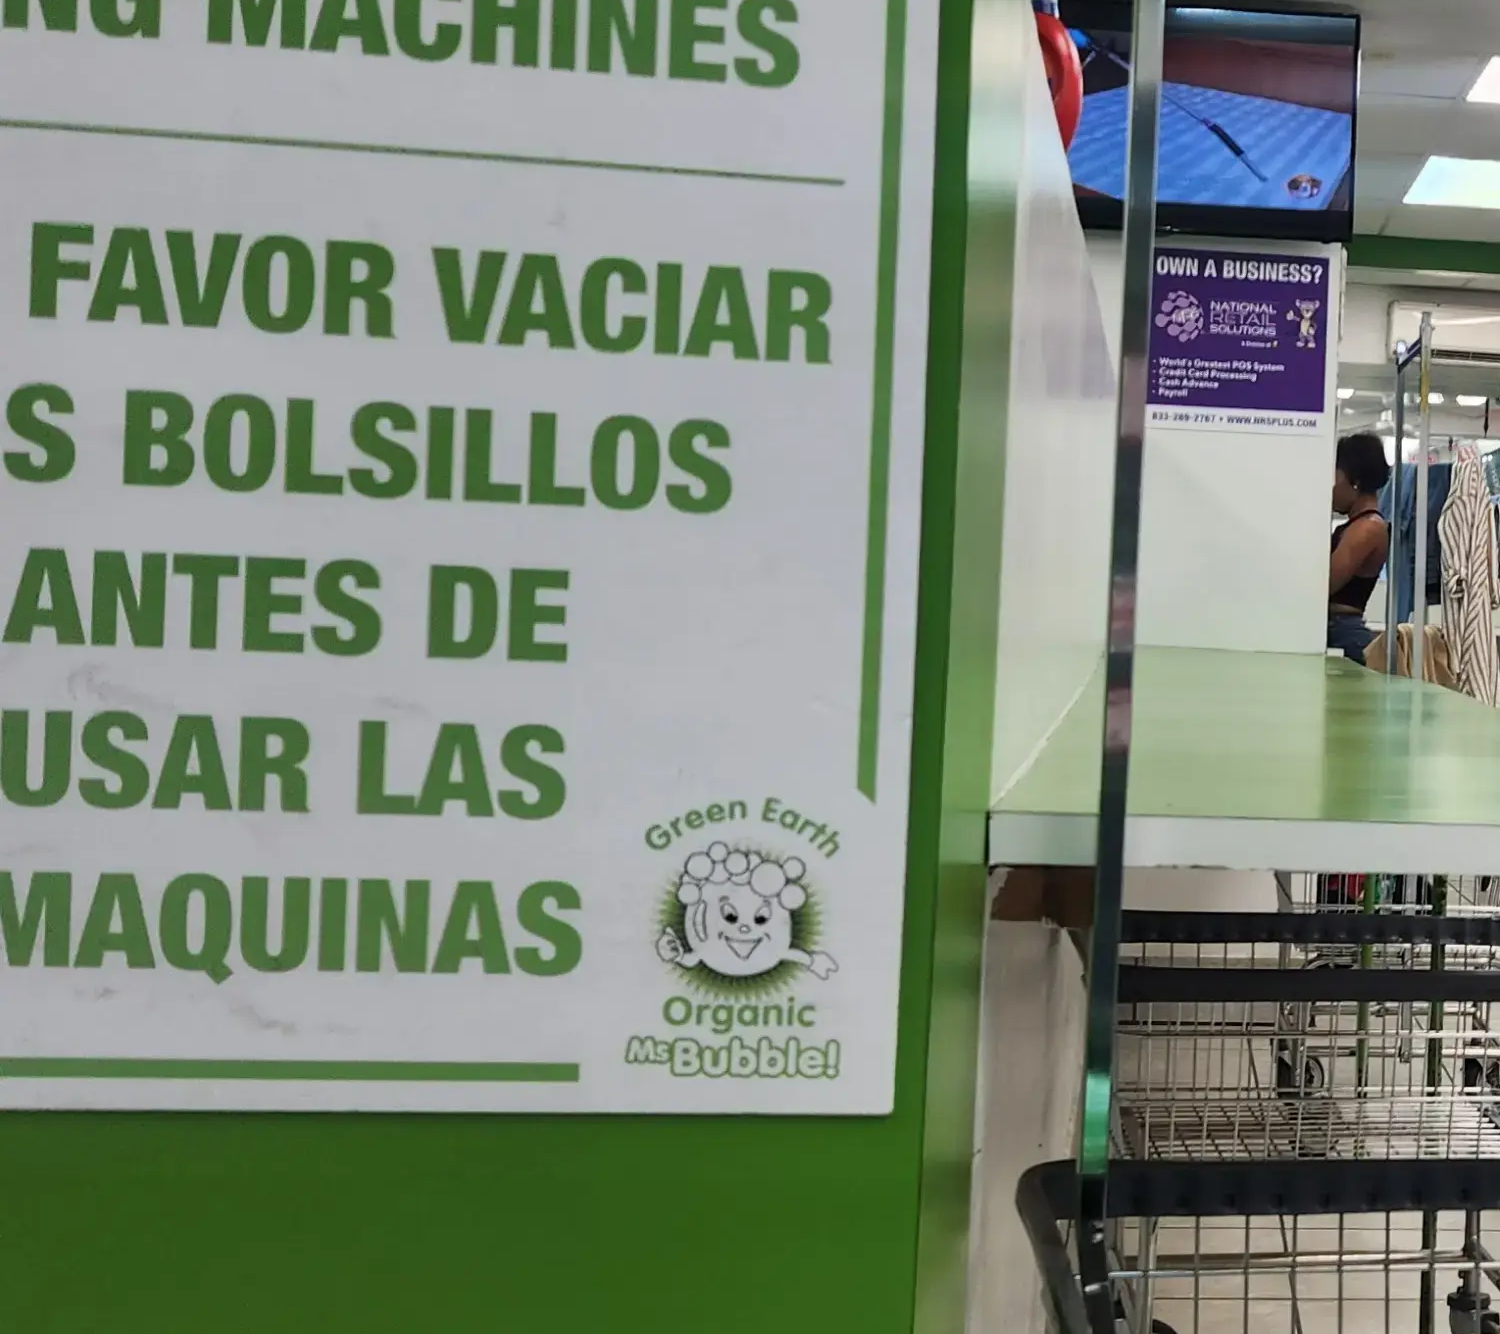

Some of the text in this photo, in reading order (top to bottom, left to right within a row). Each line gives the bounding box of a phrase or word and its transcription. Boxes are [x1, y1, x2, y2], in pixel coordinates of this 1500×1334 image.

[1156, 255, 1323, 284] OWN A BUSINESS?
[30, 223, 829, 365] FAVOR VACIAR
[1210, 299, 1277, 315] NATIONAL
[1210, 310, 1276, 326] RETAIL
[1210, 323, 1276, 337] SOLUTIONS
[1159, 356, 1285, 373] World's Greatest POS System
[1159, 367, 1257, 382] Credit Card Processing
[1158, 387, 1188, 398] Payroll
[1159, 377, 1219, 389] Cash Advance
[123, 391, 731, 513] BOLSILLOS
[4, 550, 570, 663] ANTES DE
[0, 712, 564, 818] USAR LAS
[645, 797, 840, 859] Green Earth
[0, 871, 582, 982] MAQUINAS
[662, 996, 815, 1034] Organic
[670, 1036, 840, 1079] Bubble!
